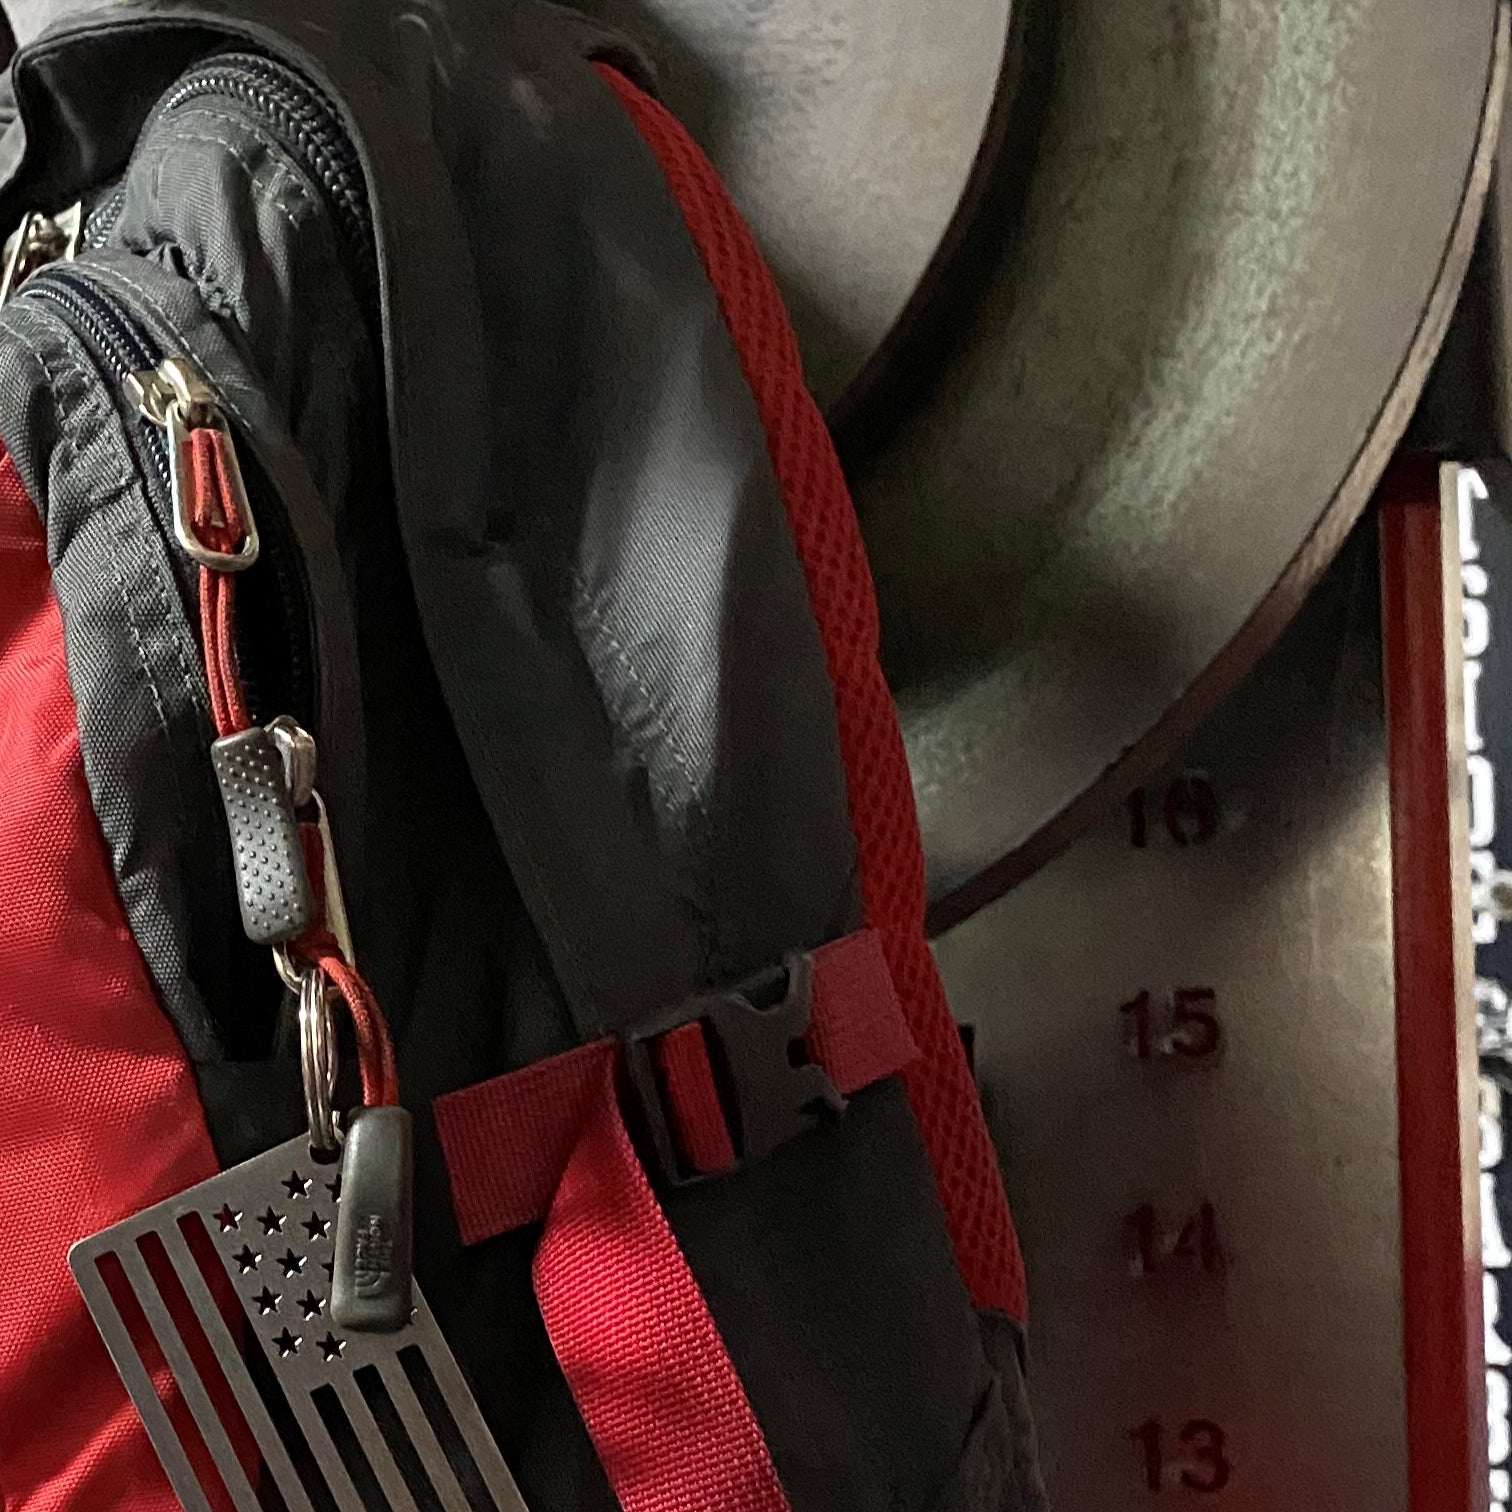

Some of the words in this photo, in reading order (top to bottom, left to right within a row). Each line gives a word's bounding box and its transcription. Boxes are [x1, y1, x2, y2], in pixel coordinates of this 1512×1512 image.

[1121, 986, 1222, 1060] 15
[1124, 1202, 1228, 1275] 14
[1127, 1416, 1231, 1494] 13
